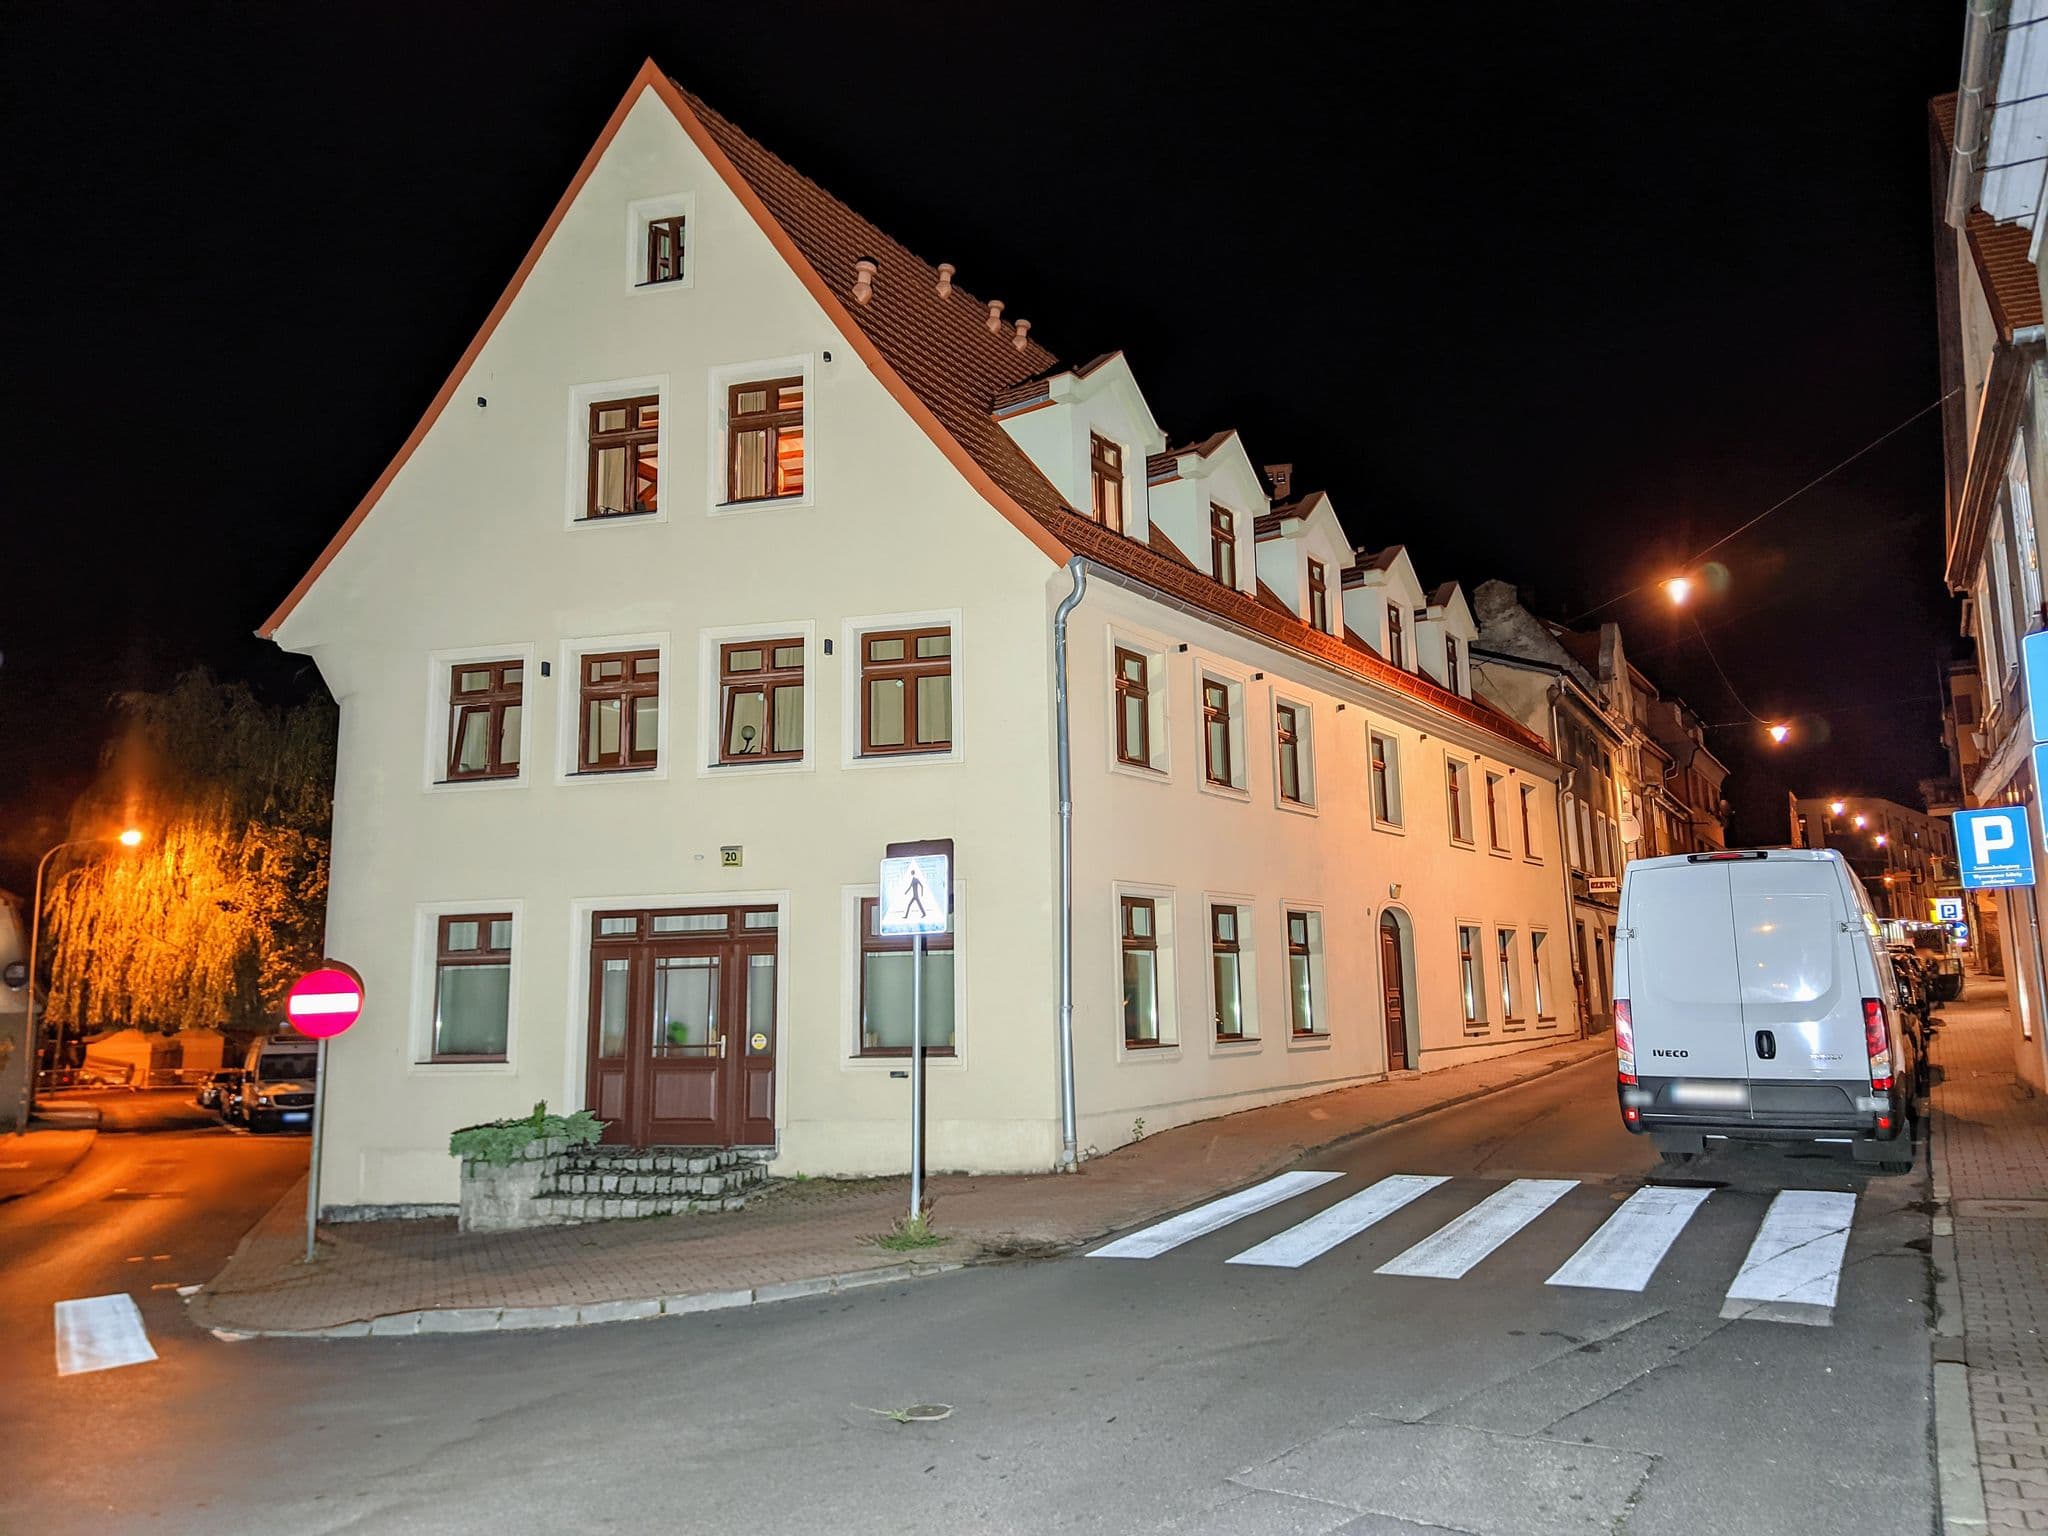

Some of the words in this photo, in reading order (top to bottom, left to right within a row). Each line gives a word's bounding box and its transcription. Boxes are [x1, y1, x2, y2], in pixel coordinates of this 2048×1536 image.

[1971, 815, 2014, 864] P
[725, 852, 737, 862] 20
[1943, 906, 1955, 917] P
[1652, 1049, 1689, 1058] IVECO
